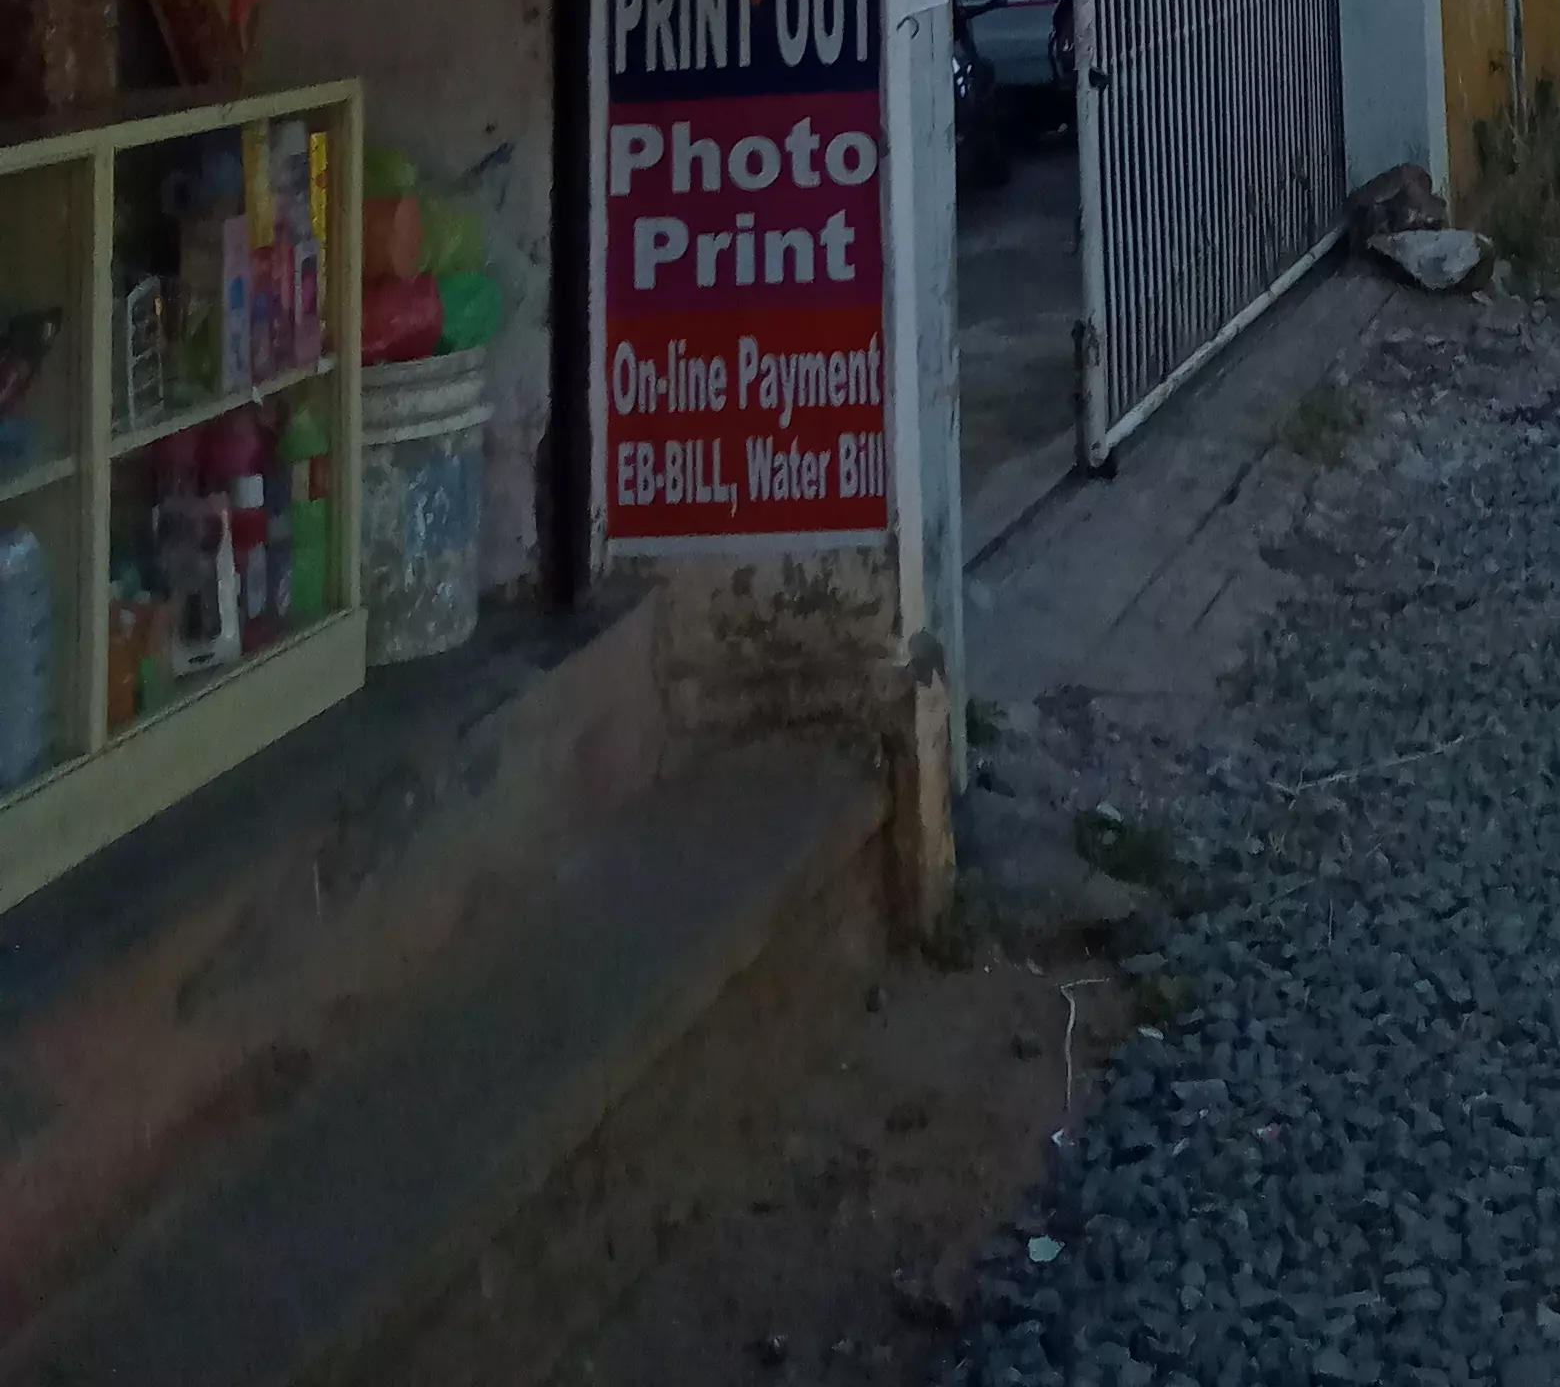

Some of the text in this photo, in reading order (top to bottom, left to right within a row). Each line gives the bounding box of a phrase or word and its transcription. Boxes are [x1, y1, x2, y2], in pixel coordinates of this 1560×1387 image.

[610, 116, 879, 197] Photo
[633, 209, 856, 291] Print
[612, 331, 883, 430] On-line Payment
[617, 430, 886, 519] EB-BILL, Water Bill
